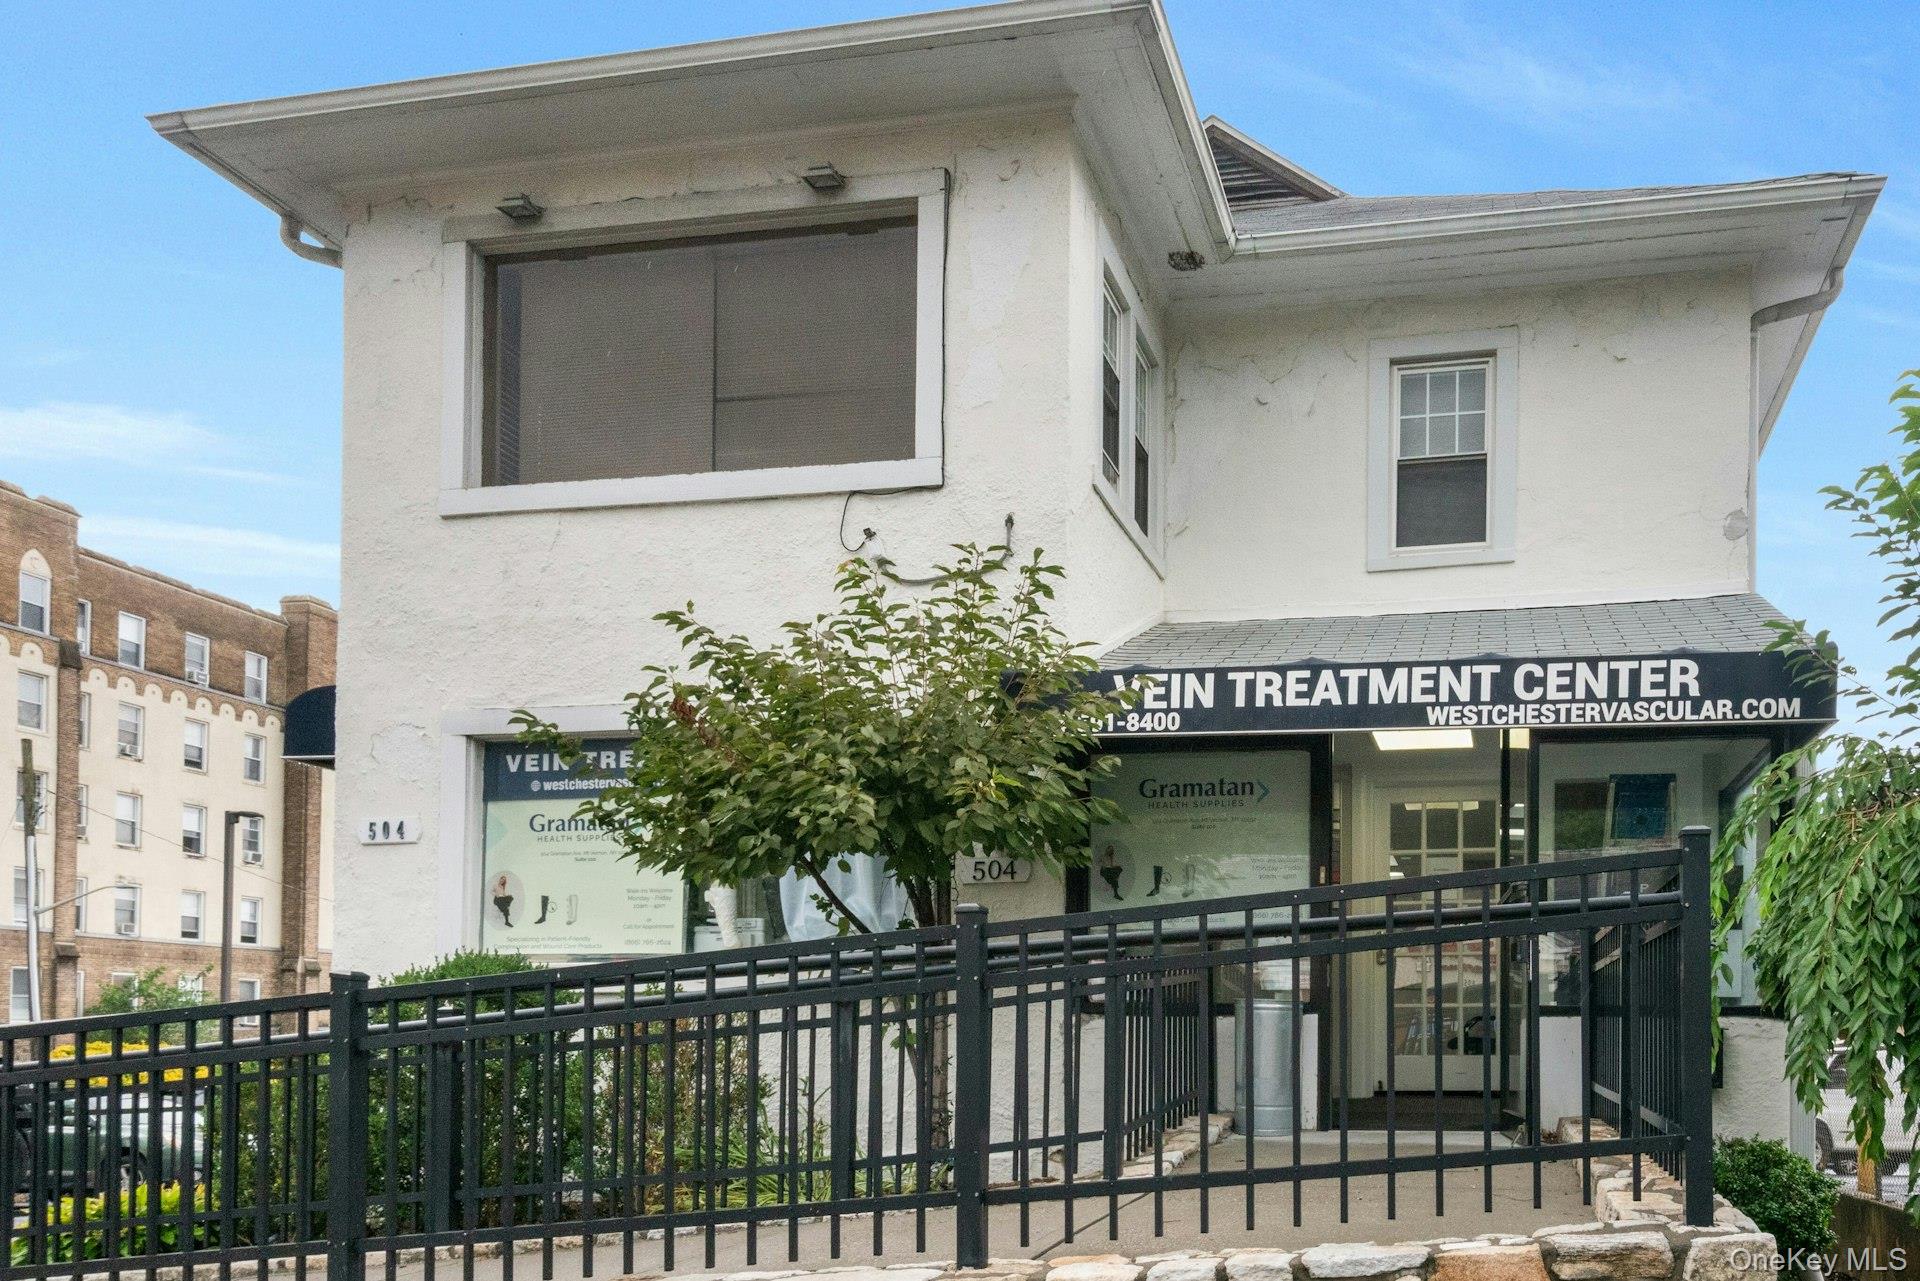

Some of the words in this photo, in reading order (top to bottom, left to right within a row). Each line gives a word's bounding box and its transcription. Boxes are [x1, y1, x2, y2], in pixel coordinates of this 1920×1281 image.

[1227, 663, 1500, 708] TREATMENT
[1513, 658, 1701, 702] CENTER
[1426, 697, 1801, 726] WESTCHESTERVASCULAR.COM
[1138, 777, 1255, 799] Gramatan
[1147, 800, 1189, 810] HEALTH
[1192, 799, 1245, 809] SUPPLIES
[367, 820, 405, 841] 504
[537, 835, 573, 843] HEALTH
[972, 860, 1017, 881] 504
